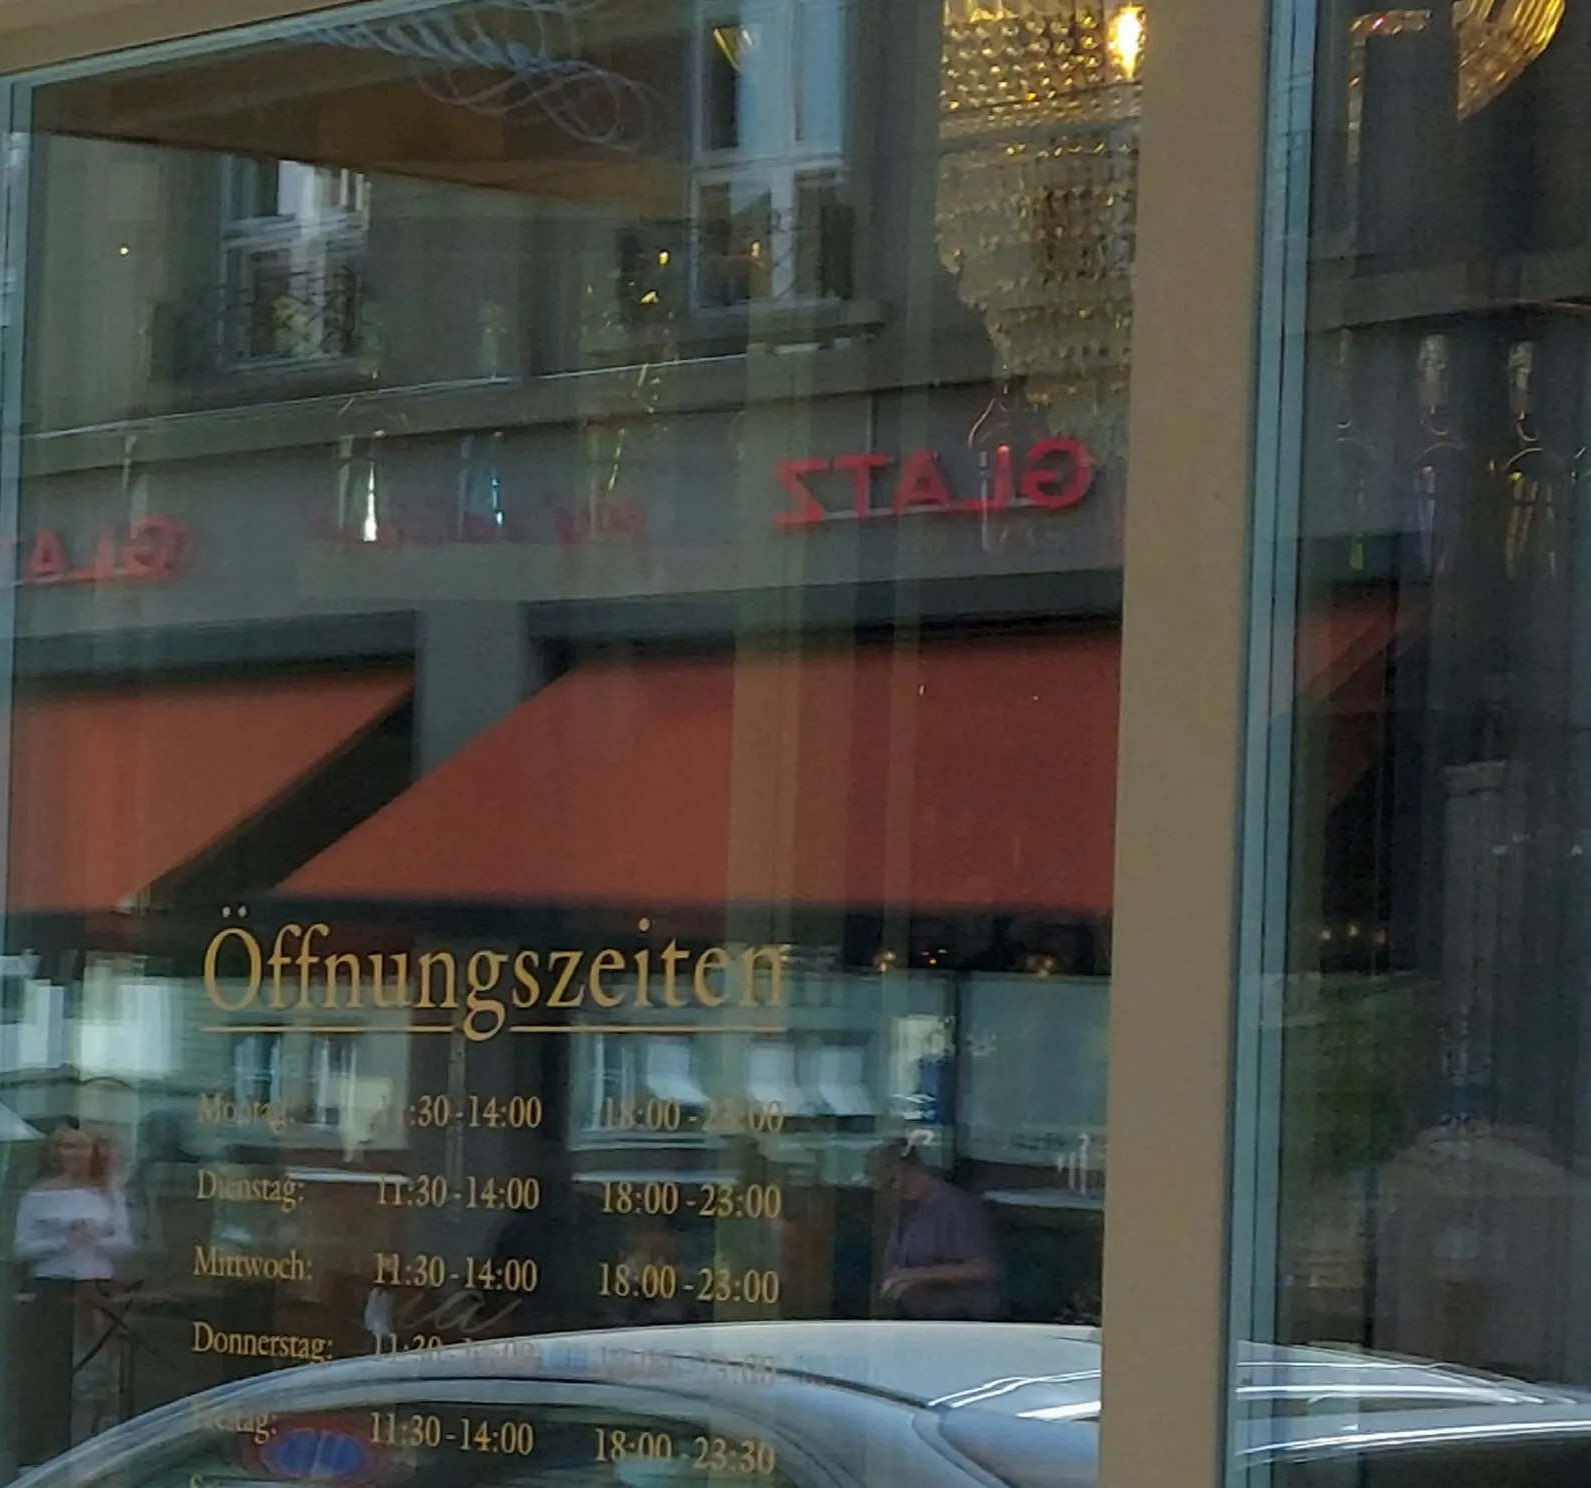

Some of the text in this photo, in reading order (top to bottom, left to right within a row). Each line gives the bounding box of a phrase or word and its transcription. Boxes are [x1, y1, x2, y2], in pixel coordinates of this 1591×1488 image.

[203, 905, 785, 1042] Öffnungszeiten
[192, 1238, 313, 1281] Mittwoch:
[191, 1320, 334, 1364] Donnerstag:
